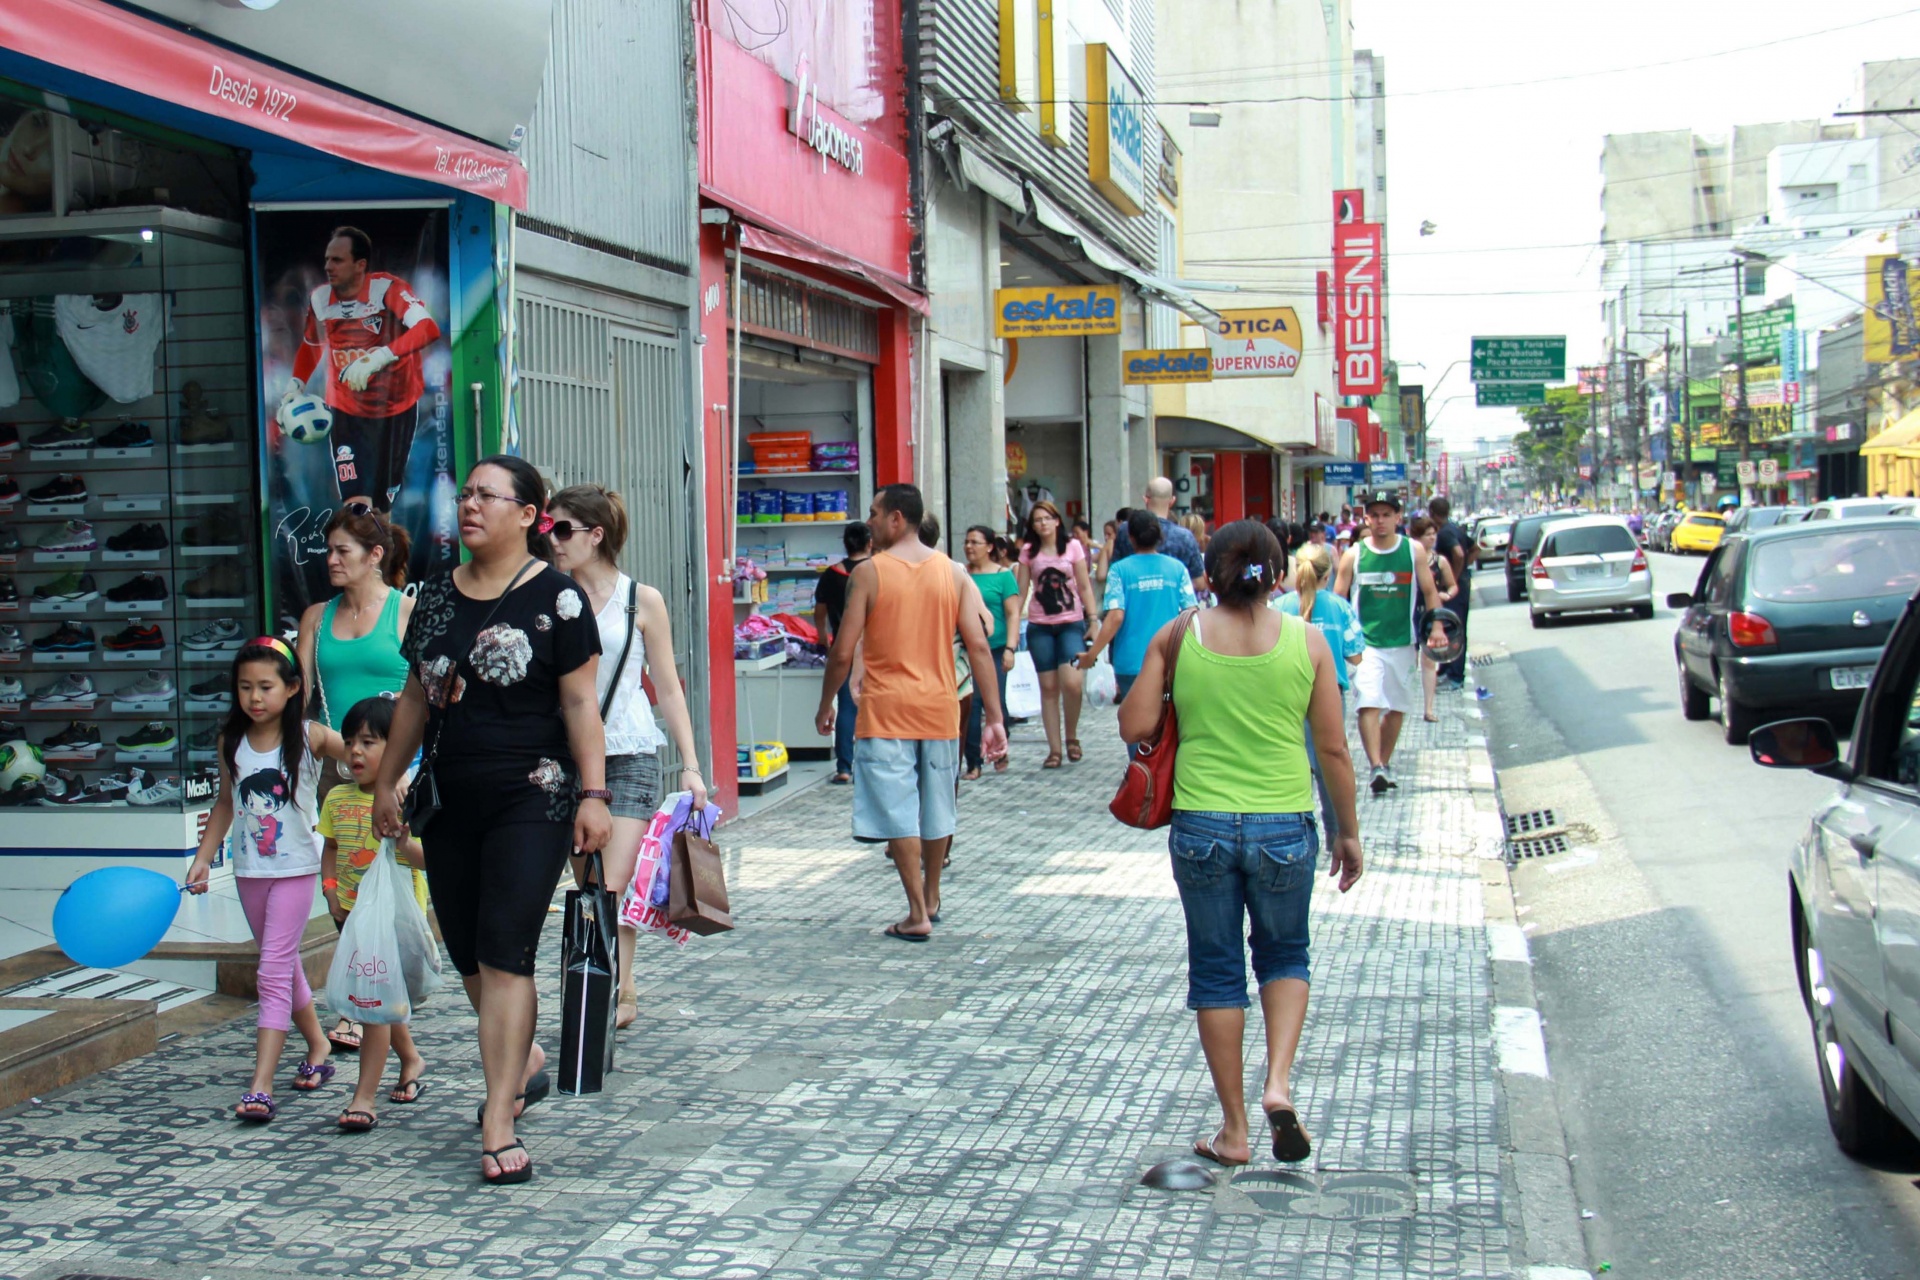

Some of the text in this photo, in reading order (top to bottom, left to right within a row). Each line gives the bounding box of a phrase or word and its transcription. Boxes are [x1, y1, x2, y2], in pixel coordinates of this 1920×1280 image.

[209, 65, 297, 122] Desde 1972
[1003, 291, 1115, 321] eskala
[1344, 238, 1375, 386] BESNI
[1218, 317, 1288, 335] ÓTICA
[1245, 339, 1256, 352] A
[1523, 341, 1544, 349] Faria
[1128, 352, 1208, 374] eskala
[1509, 358, 1552, 366] Municipal
[338, 462, 357, 482] 01
[1333, 465, 1352, 473] Prado
[186, 778, 213, 799] Mash.
